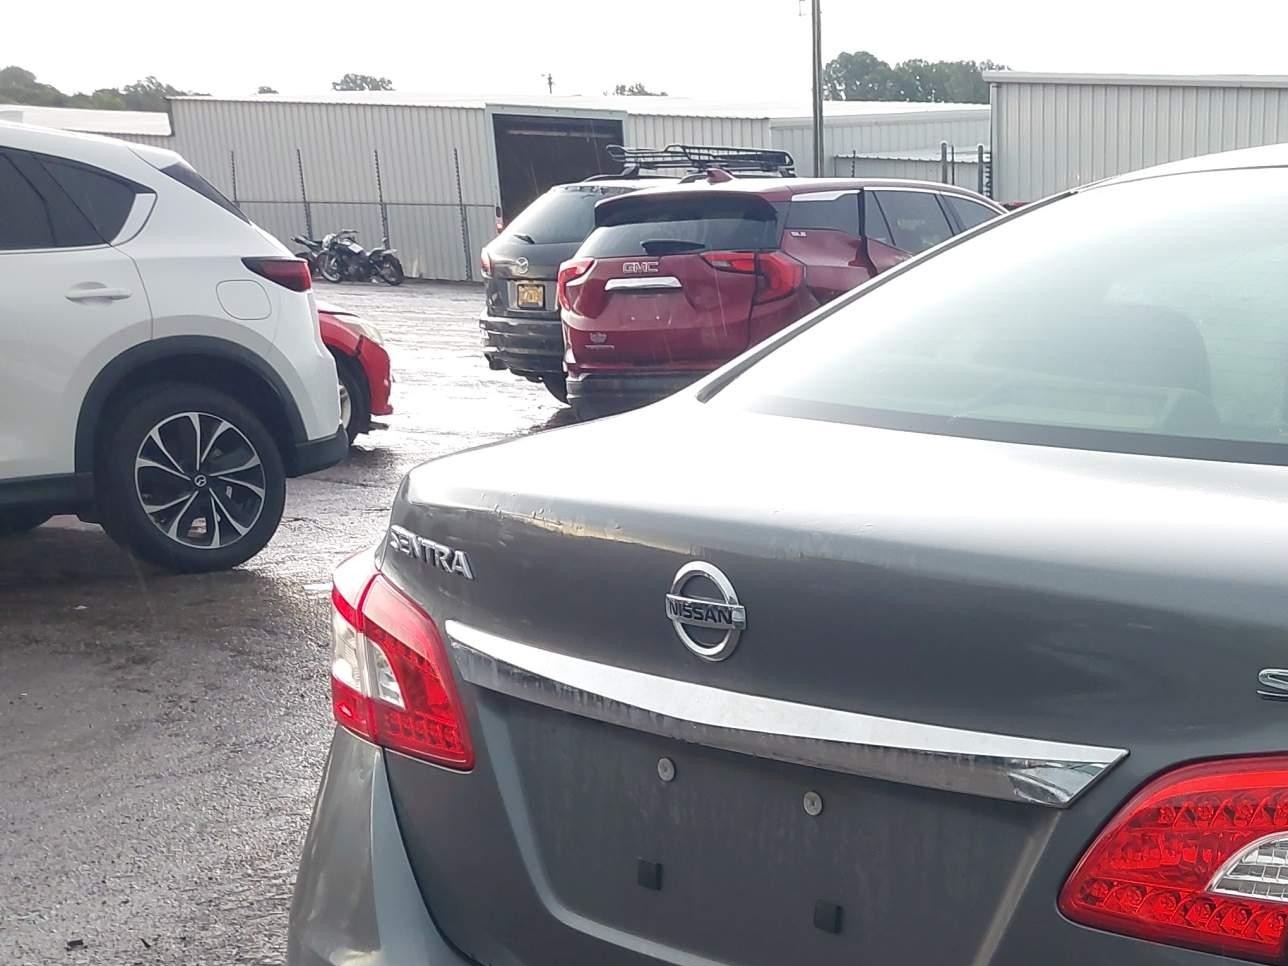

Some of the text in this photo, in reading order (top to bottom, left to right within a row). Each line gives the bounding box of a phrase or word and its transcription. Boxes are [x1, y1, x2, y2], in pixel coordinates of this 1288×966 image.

[622, 261, 659, 273] GMC
[389, 524, 474, 580] SENTRA
[668, 599, 734, 625] NISSAN
